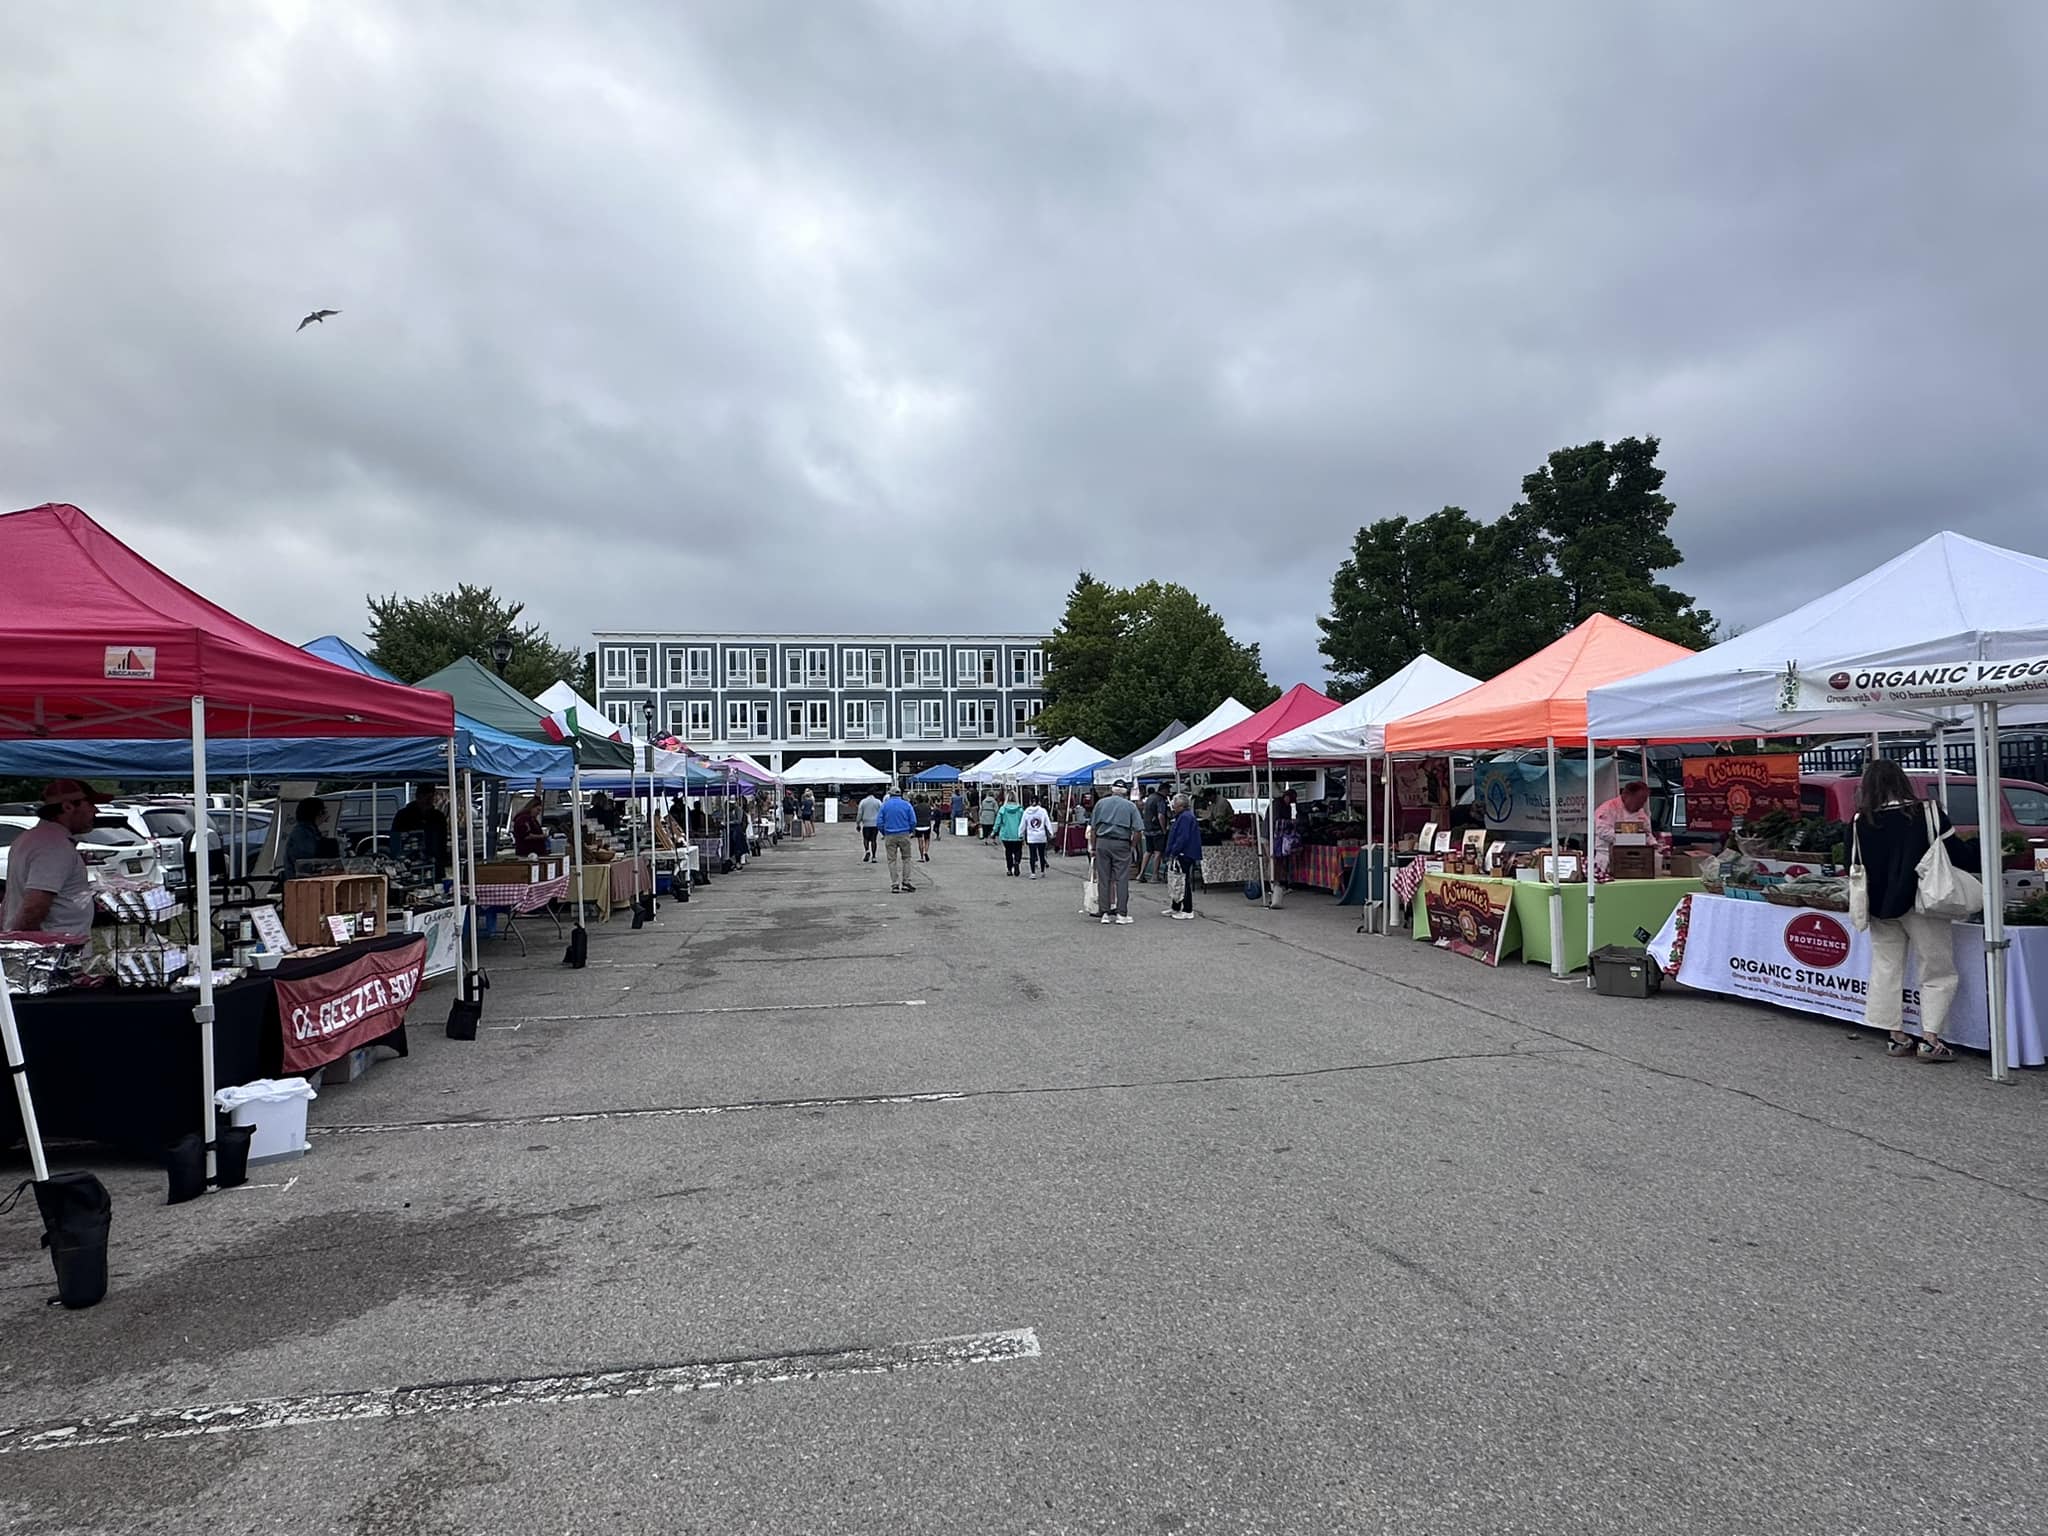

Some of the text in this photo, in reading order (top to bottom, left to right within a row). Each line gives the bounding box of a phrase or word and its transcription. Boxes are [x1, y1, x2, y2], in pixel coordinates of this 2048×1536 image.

[1855, 659, 2048, 690] ORGANIC VEGG
[1908, 687, 1947, 700] harmful
[1707, 761, 1768, 786] Winnie's
[1442, 882, 1489, 913] Winnie's
[1789, 934, 1848, 950] PROVIDENCE
[1729, 956, 1792, 980] ORGANIC
[319, 979, 389, 1034] GEEZER
